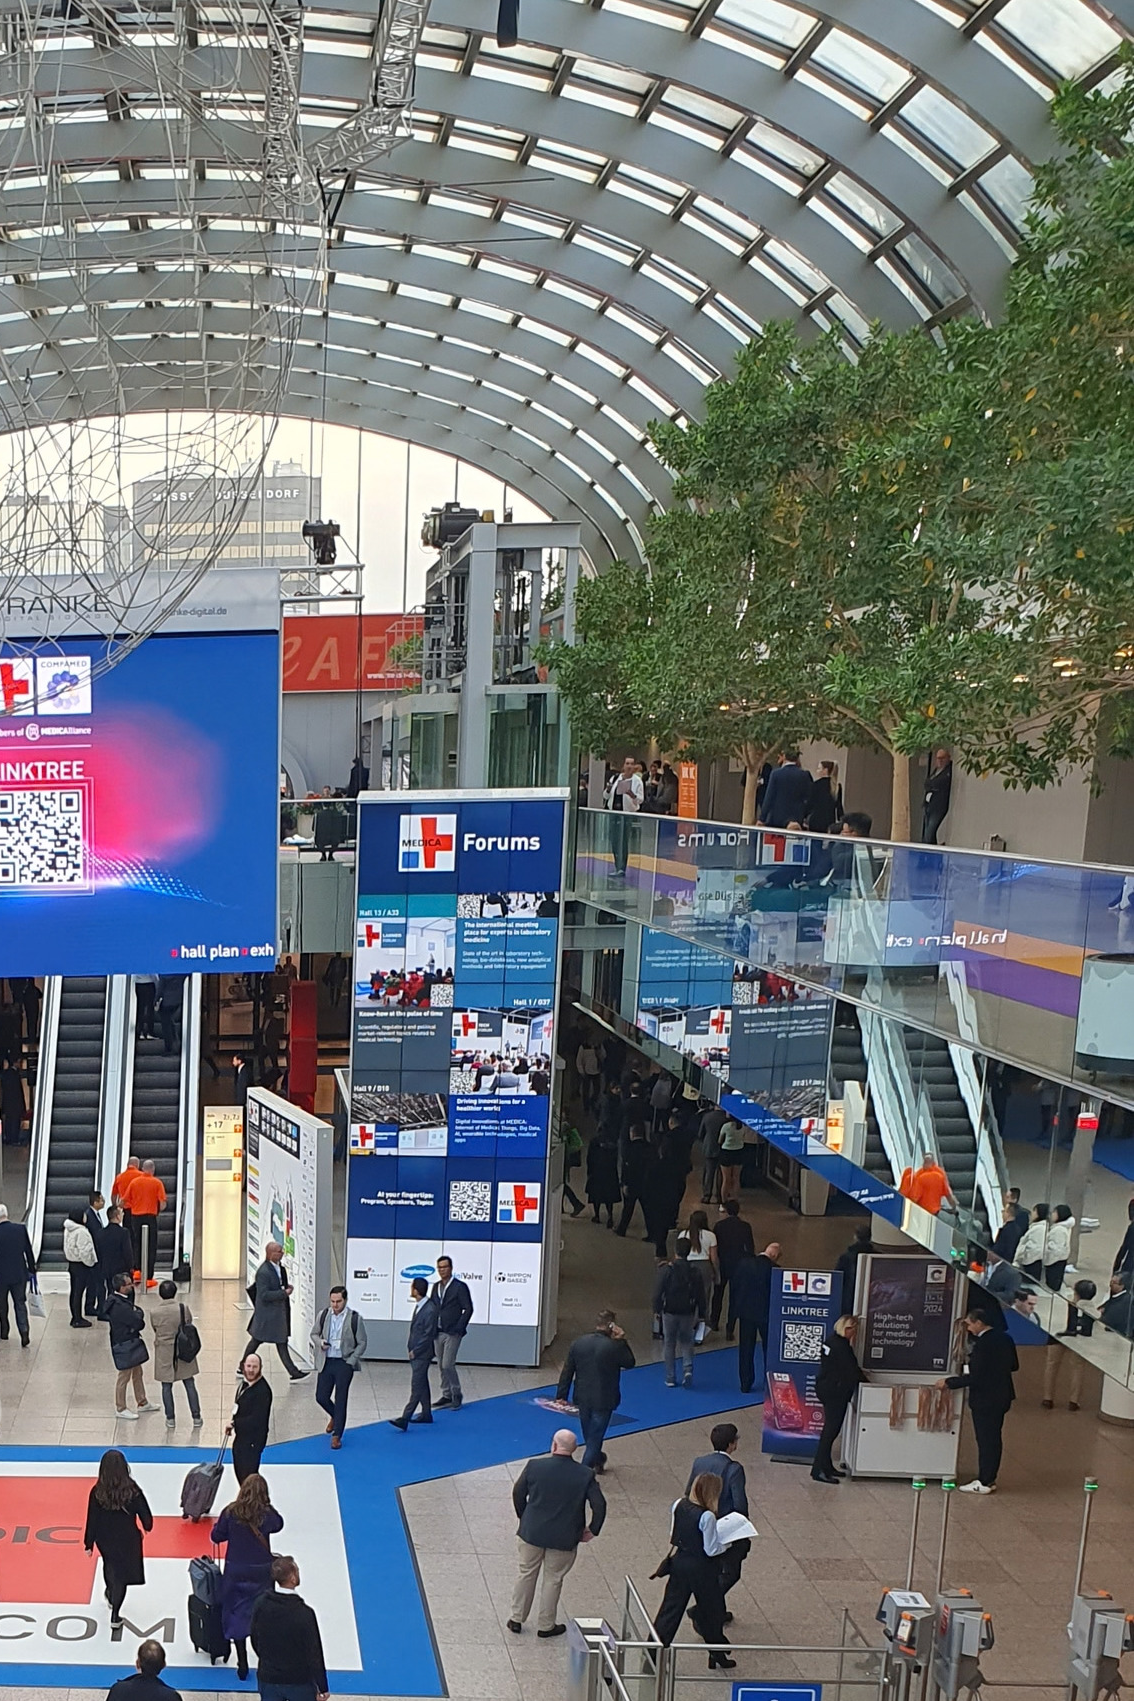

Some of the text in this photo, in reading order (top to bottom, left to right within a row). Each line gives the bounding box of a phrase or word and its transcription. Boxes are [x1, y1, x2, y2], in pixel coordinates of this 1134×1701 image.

[152, 491, 195, 501] MSSE
[161, 606, 227, 618] fnke-digital.de
[16, 728, 25, 737] of
[401, 838, 442, 847] MEDICA
[463, 833, 541, 851] Forums
[359, 909, 373, 917] Hall
[181, 942, 274, 961] hall plan exh
[456, 1098, 477, 1106] Driving
[213, 1120, 223, 1128] 17
[385, 1191, 400, 1199] your
[781, 1305, 829, 1317] LINKTREE
[923, 1304, 943, 1313] 2024
[873, 1312, 913, 1323] High-tech
[873, 1321, 910, 1329] solutions
[872, 1329, 917, 1338] for medical
[871, 1337, 915, 1348] technology
